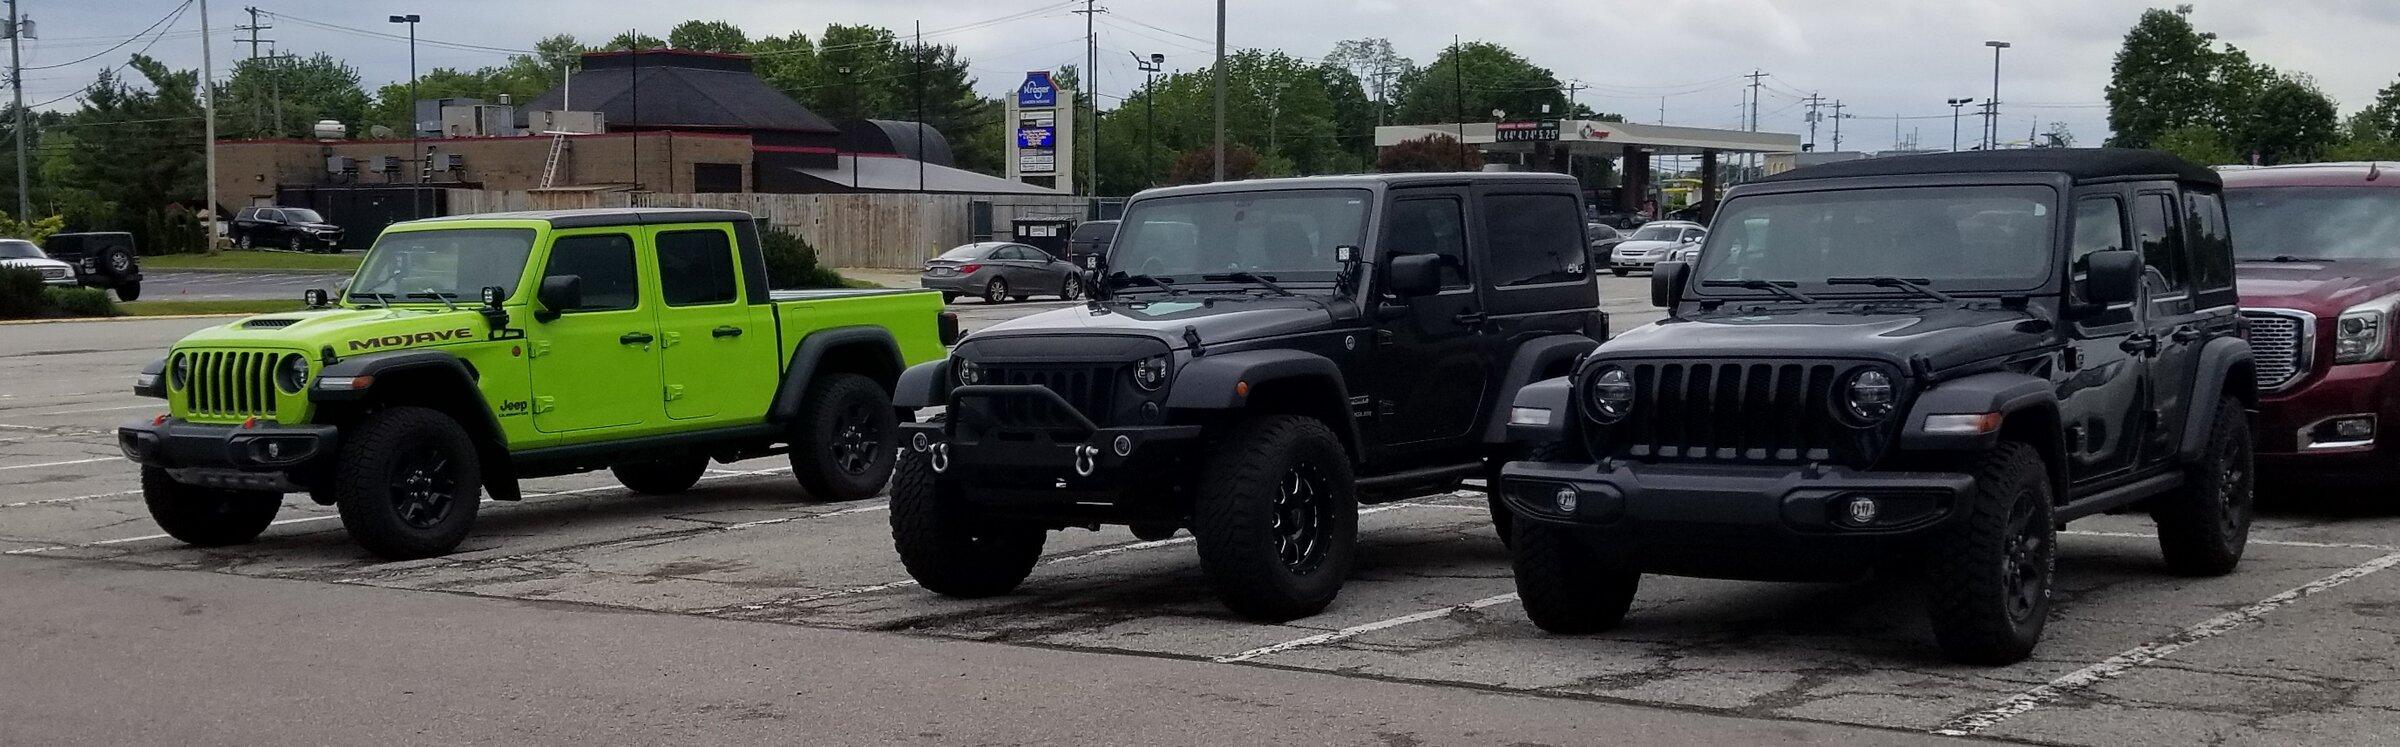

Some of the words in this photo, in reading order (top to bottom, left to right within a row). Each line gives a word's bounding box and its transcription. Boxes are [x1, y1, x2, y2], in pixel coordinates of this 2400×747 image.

[1023, 81, 1050, 99] Kroger
[348, 328, 473, 350] MOJAVE
[499, 400, 528, 411] Jeep
